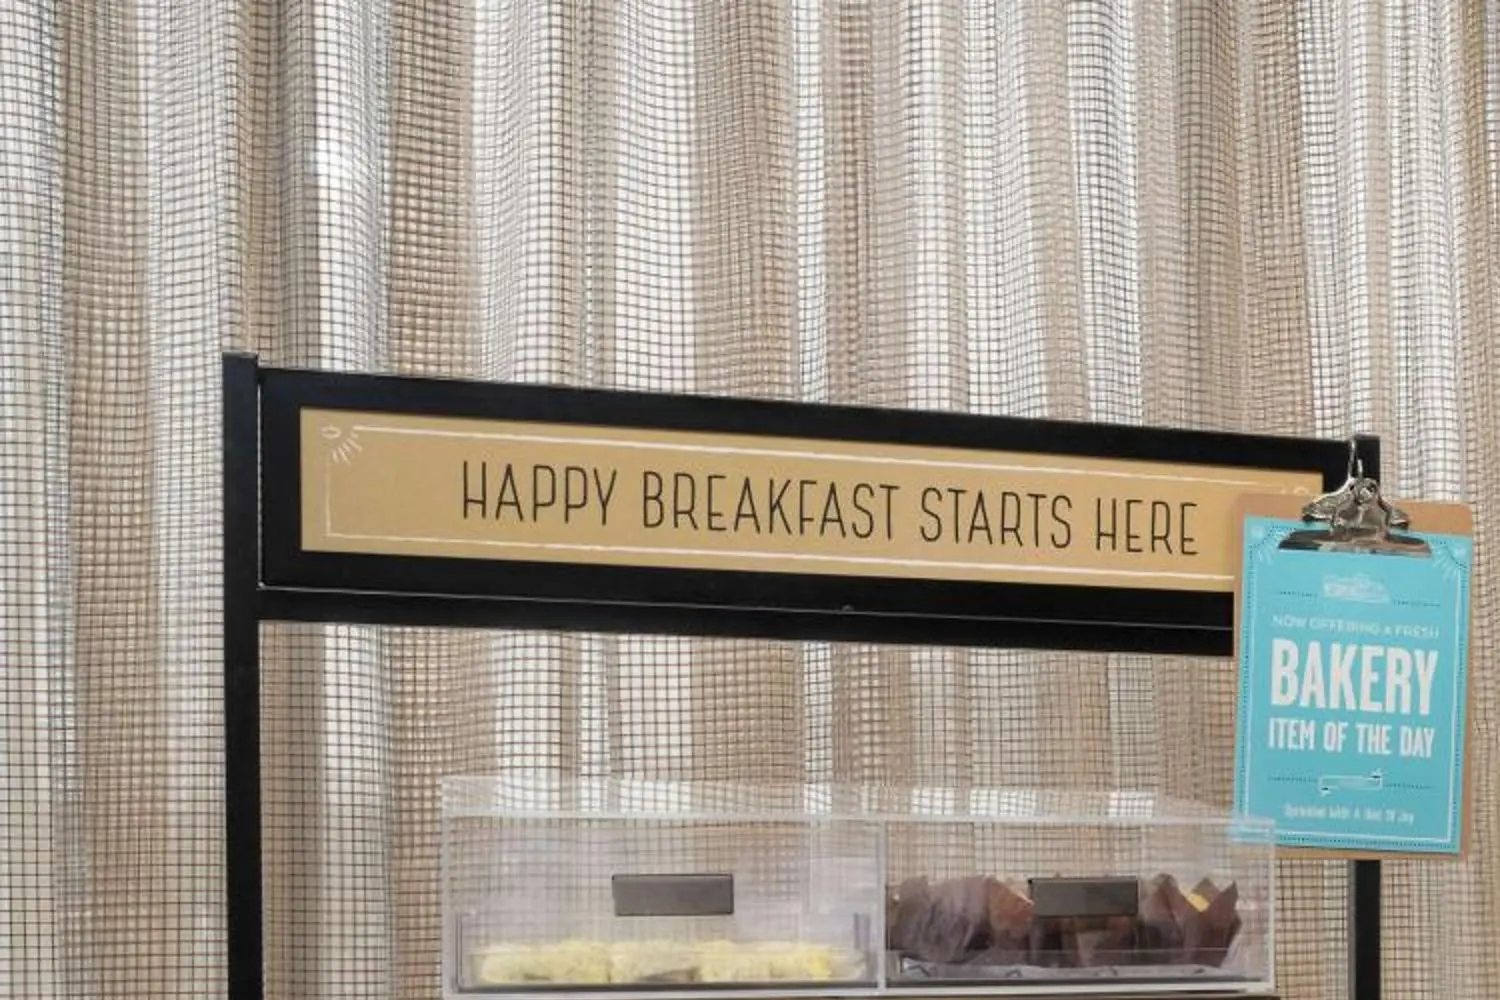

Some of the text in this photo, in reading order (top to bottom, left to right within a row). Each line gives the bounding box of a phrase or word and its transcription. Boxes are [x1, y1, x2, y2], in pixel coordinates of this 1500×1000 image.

[461, 460, 1199, 555] HAPPY BREAKFAST STARTS HERE
[1272, 614, 1307, 629] NOW
[1395, 624, 1440, 639] FRESH
[1270, 637, 1440, 717] BAKERY
[1267, 717, 1435, 759] ITEM OF THE DAY
